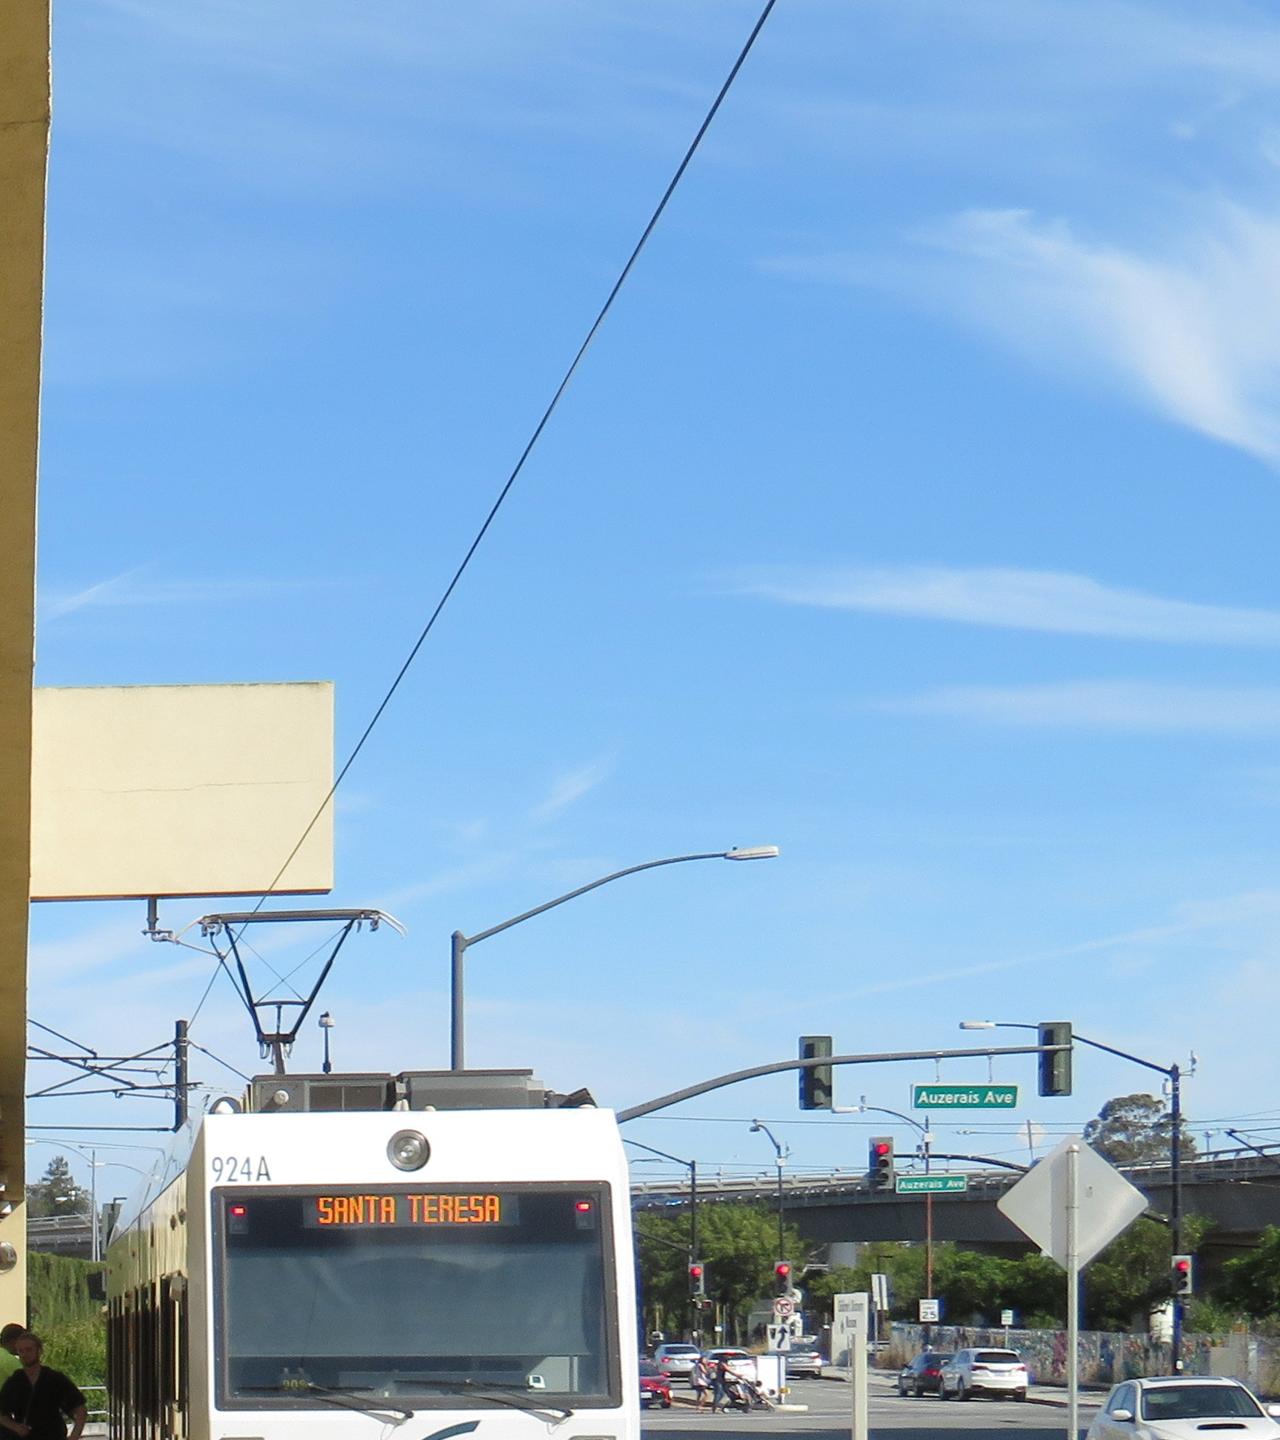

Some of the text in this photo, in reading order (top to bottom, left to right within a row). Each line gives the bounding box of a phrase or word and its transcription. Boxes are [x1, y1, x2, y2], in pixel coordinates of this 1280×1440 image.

[917, 1090, 1013, 1105] Auzerais Ave
[211, 1156, 272, 1182] 924A
[899, 1179, 965, 1190] Auzerais Ave
[317, 1195, 501, 1225] SANTA TERESA
[922, 1310, 937, 1320] 25
